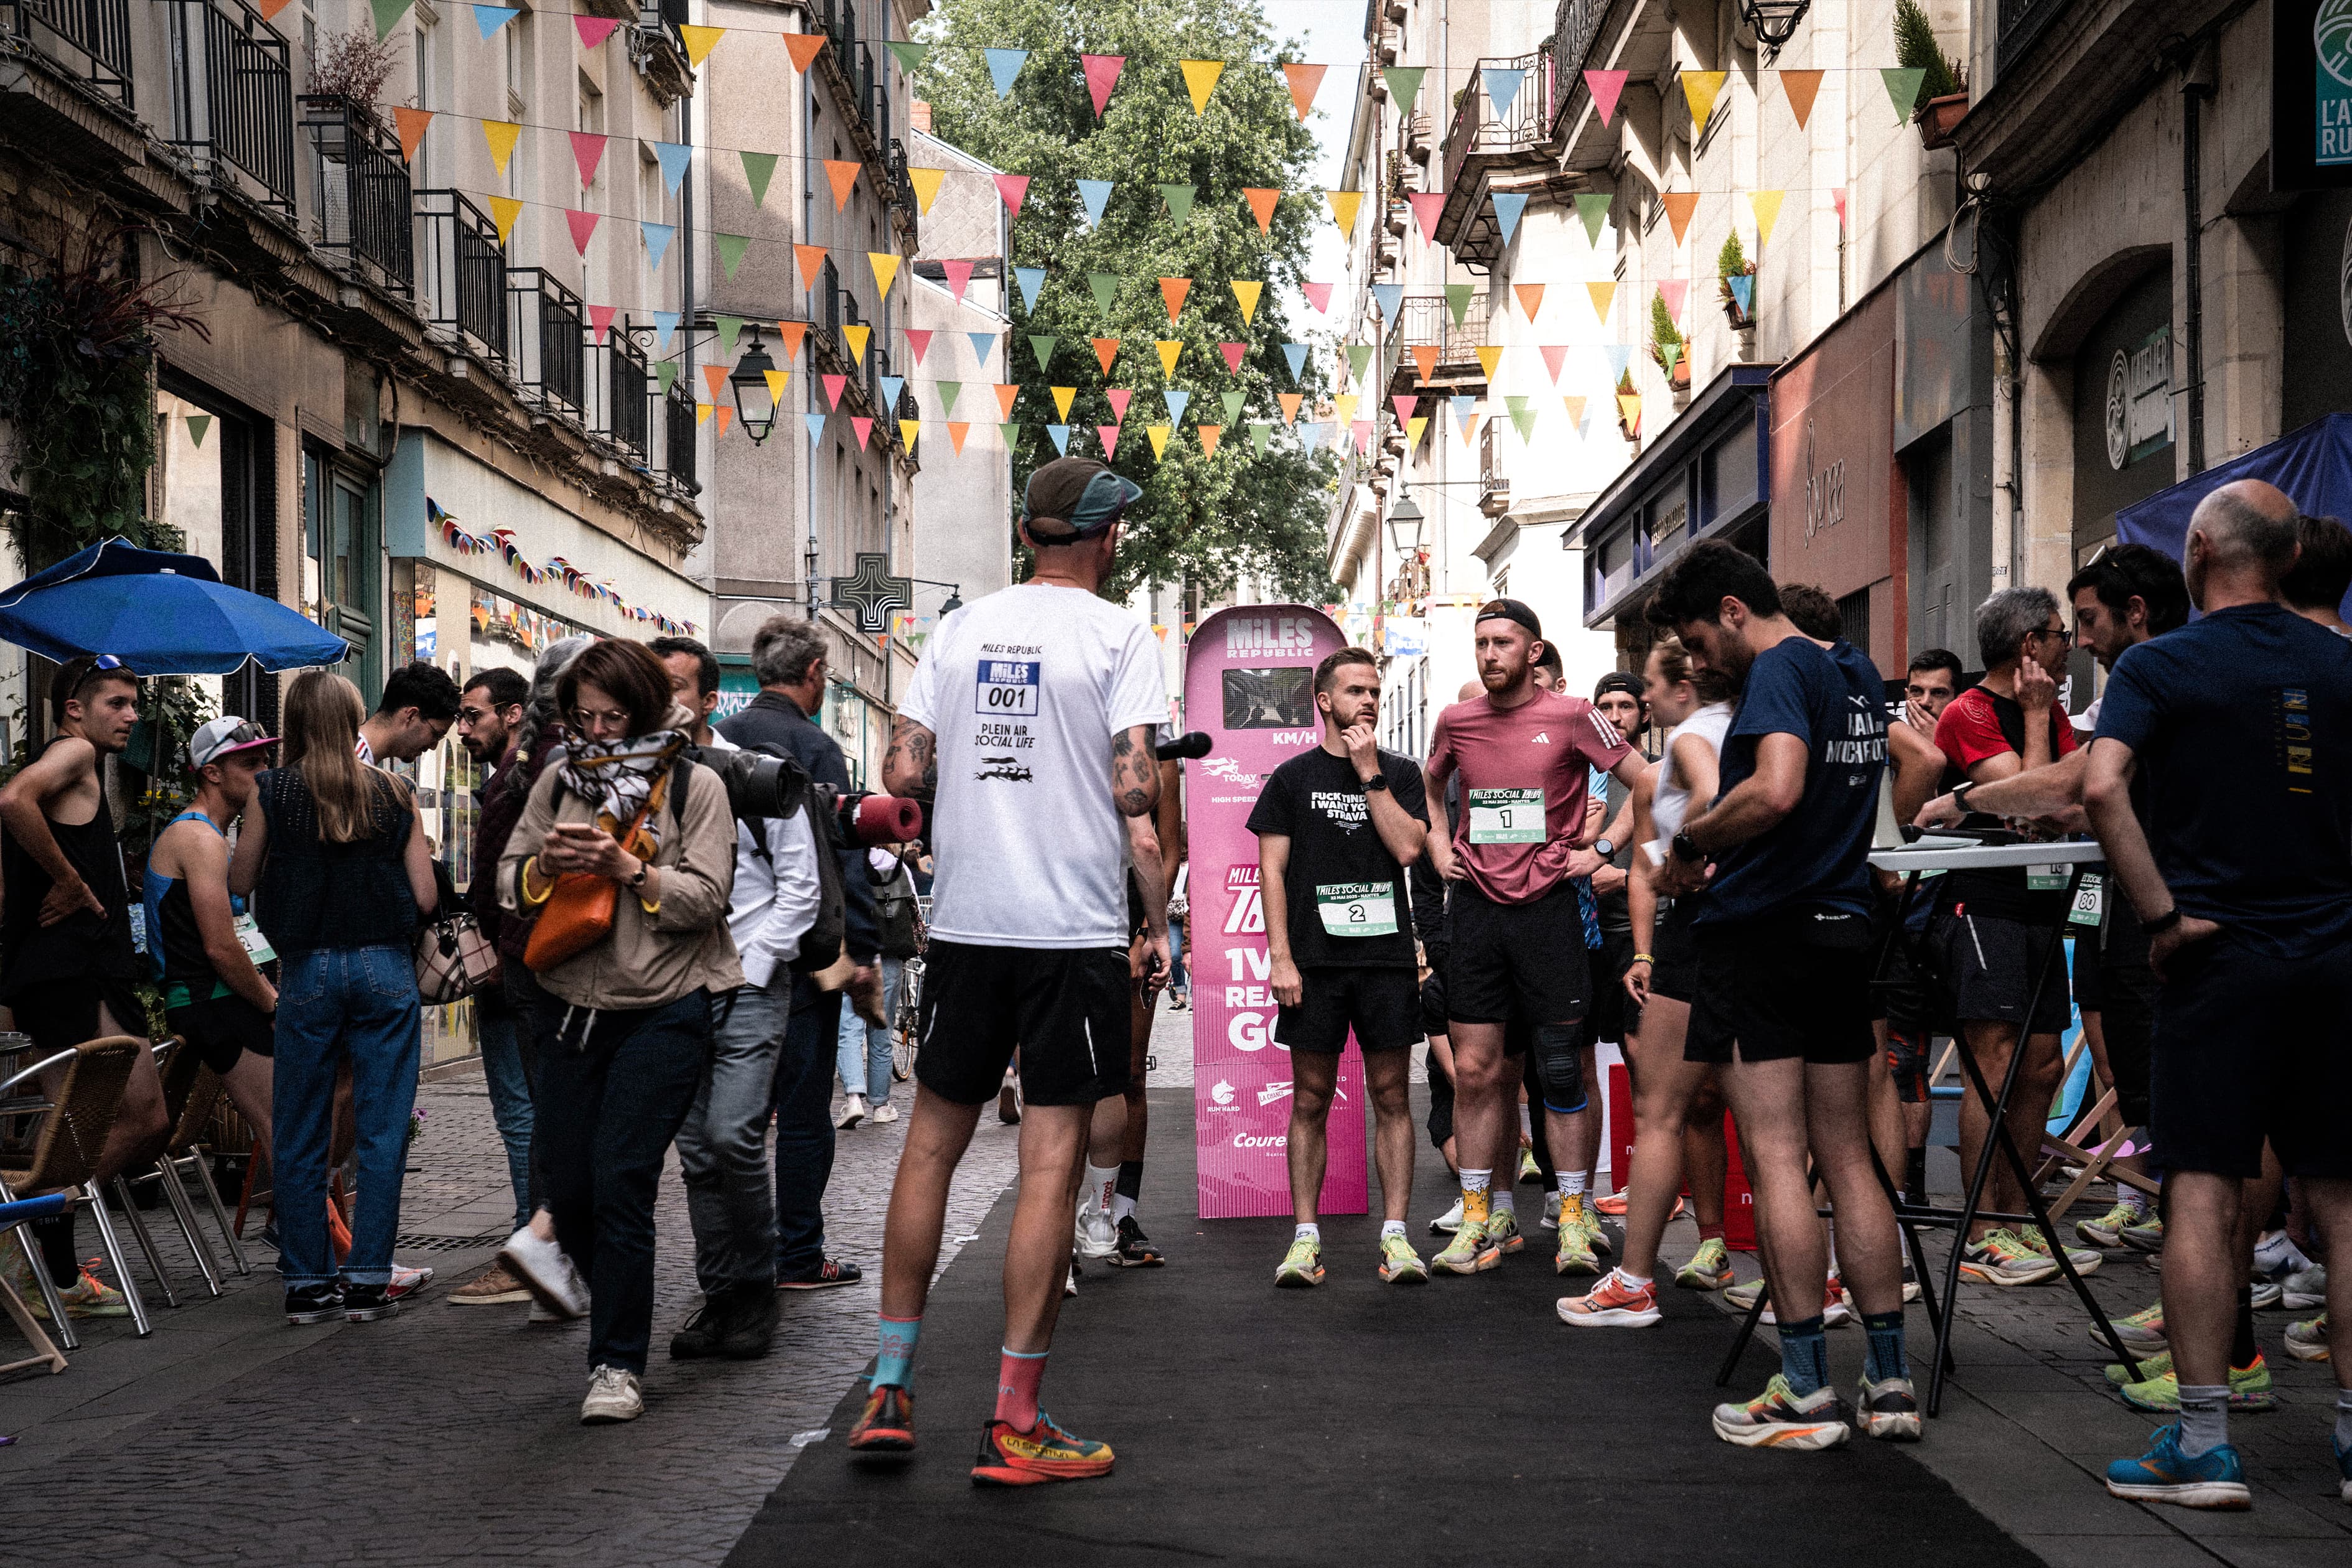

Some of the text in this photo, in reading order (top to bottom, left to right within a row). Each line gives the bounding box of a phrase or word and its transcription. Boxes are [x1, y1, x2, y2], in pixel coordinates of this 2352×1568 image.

[2322, 98, 2352, 126] L'A
[981, 643, 1042, 654] MILES REPUBLIC
[1226, 648, 1314, 658] REPUBLIC
[988, 687, 1025, 707] 001
[982, 724, 1027, 736] PLEIN AIR
[975, 735, 1035, 748] SOCIAL LIFE
[1273, 730, 1317, 745] KM/H
[1223, 774, 1257, 782] TODAY
[1312, 792, 1368, 803] FUCK TIND
[1472, 789, 1542, 799] MILES SOCIAL TOUR
[1311, 801, 1315, 809] I
[1317, 800, 1349, 812] WANT
[1327, 809, 1368, 821] STRAVA
[1500, 810, 1511, 828] 1
[1228, 868, 1260, 883] MILE
[1320, 883, 1391, 895] MILES SOCIAL TOUR
[2079, 893, 2096, 910] 80
[1224, 885, 1266, 933] TO
[1348, 905, 1366, 922] 2
[1225, 948, 1271, 981] 1V
[1267, 1090, 1284, 1099] CHANCE
[1233, 1132, 1288, 1147] Coure
[821, 1261, 839, 1280] N
[1006, 1437, 1019, 1447] LA
